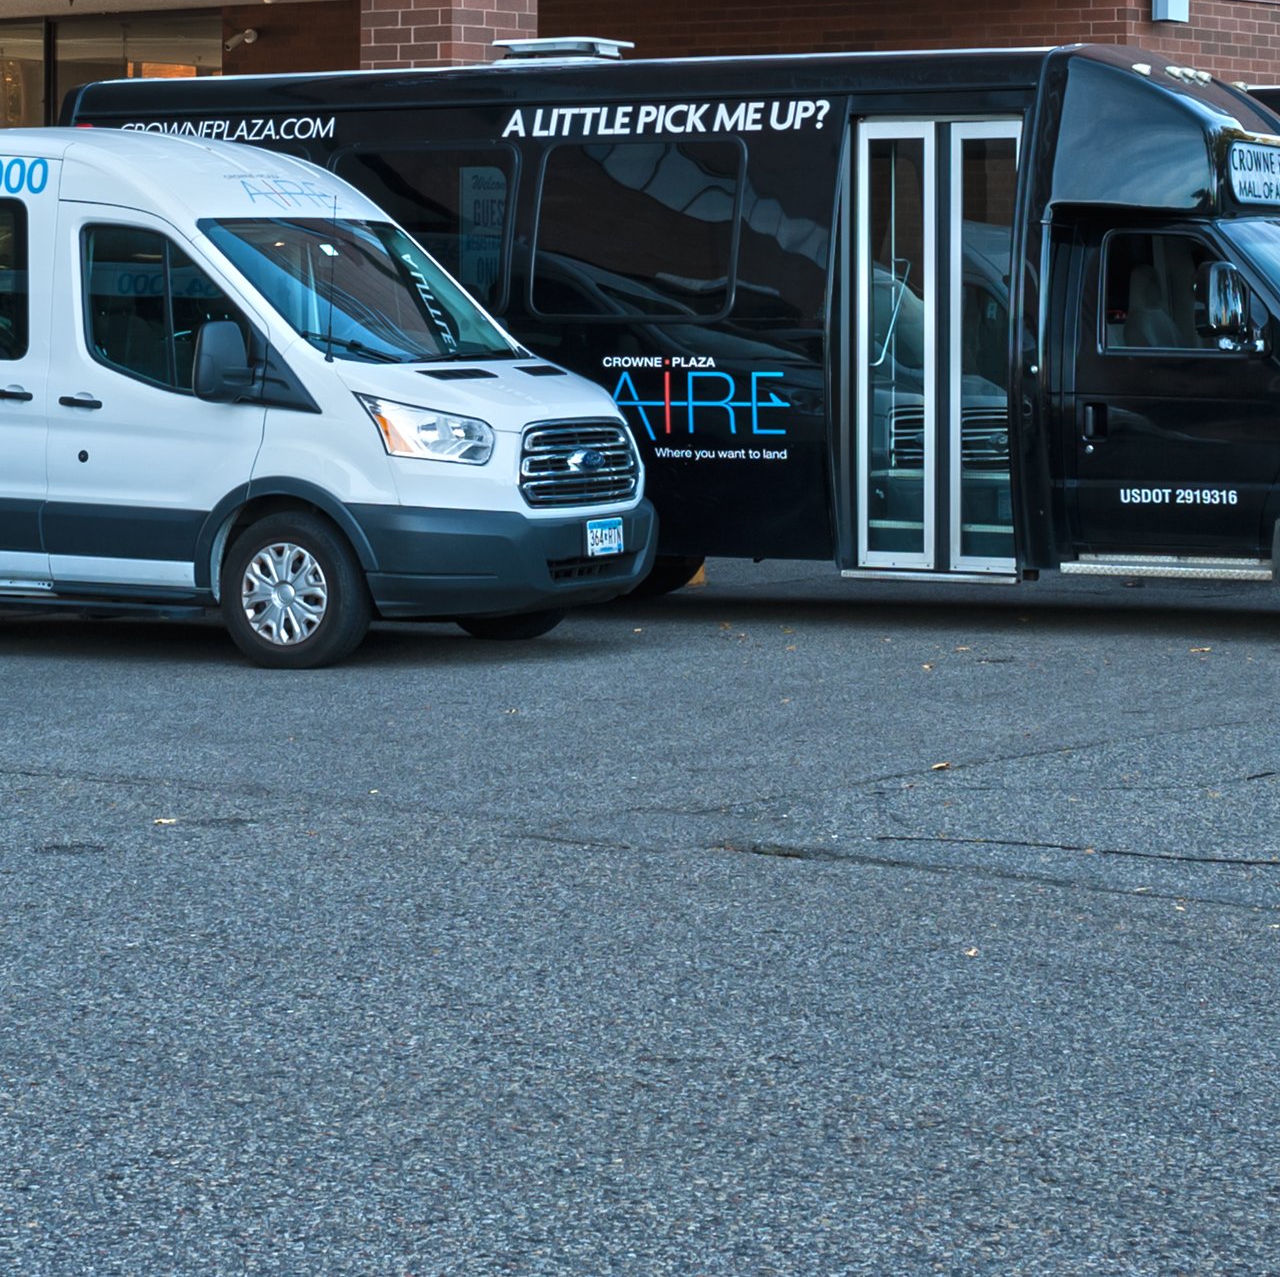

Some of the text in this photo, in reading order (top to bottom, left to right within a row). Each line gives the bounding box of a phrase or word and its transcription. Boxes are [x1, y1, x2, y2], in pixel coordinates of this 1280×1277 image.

[120, 117, 335, 141] WNEPLAZA.COM
[502, 100, 831, 137] A LITTLE PICK ME UP?
[1231, 148, 1275, 175] CROWNE
[1239, 180, 1261, 198] MALL
[1263, 182, 1274, 199] OF
[603, 356, 716, 368] CROWNE PLAZA
[612, 371, 791, 441] AIRE
[654, 447, 788, 461] Where you want to land
[1120, 488, 1238, 505] USDOT 2919316
